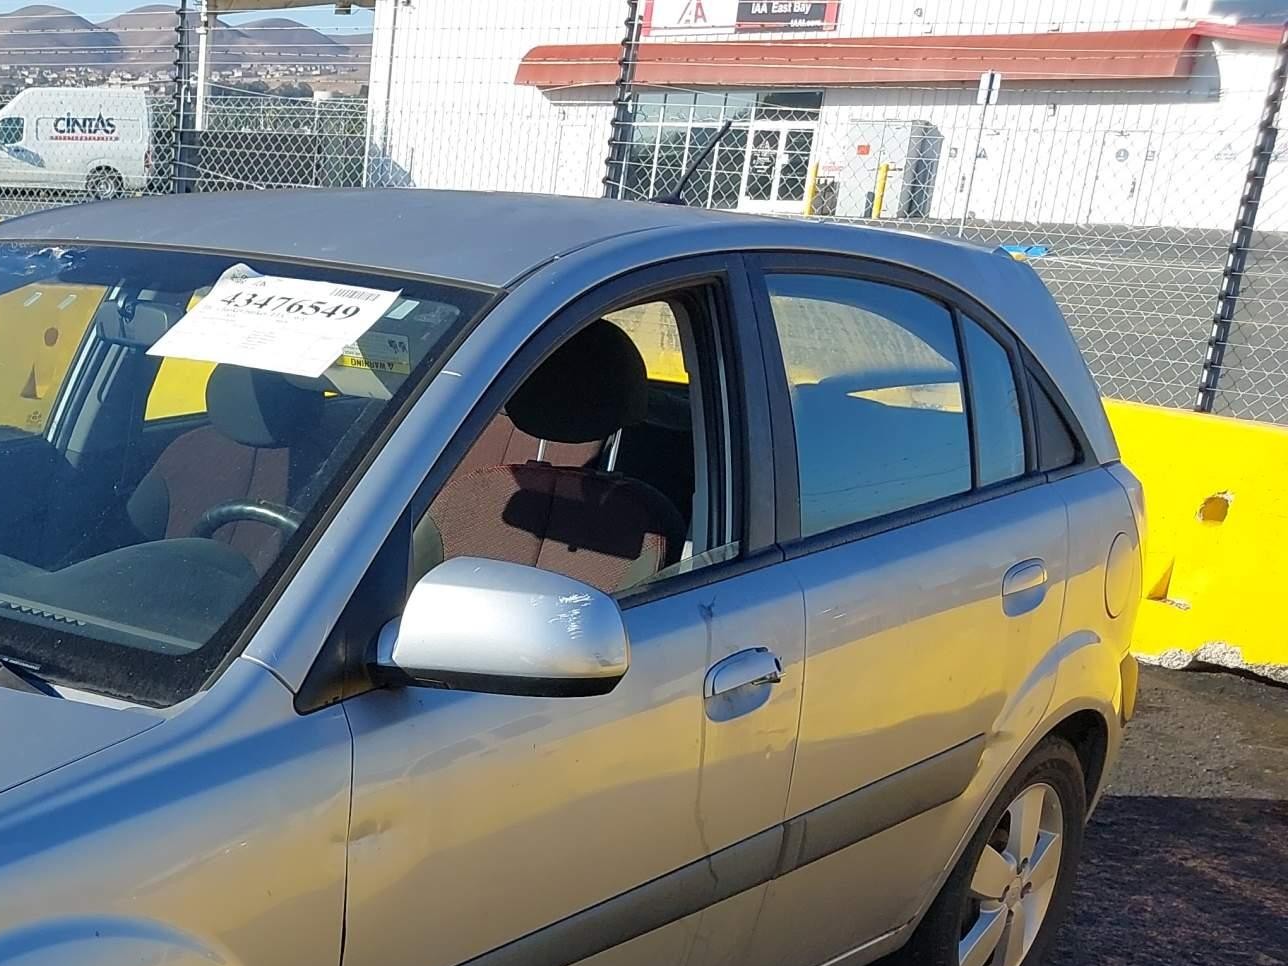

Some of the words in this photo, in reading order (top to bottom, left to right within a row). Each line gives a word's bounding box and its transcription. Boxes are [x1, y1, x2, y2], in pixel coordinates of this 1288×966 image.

[751, 2, 768, 14] IAA
[771, 1, 792, 14] East
[793, 1, 812, 15] Bay
[221, 290, 361, 321] 43476549
